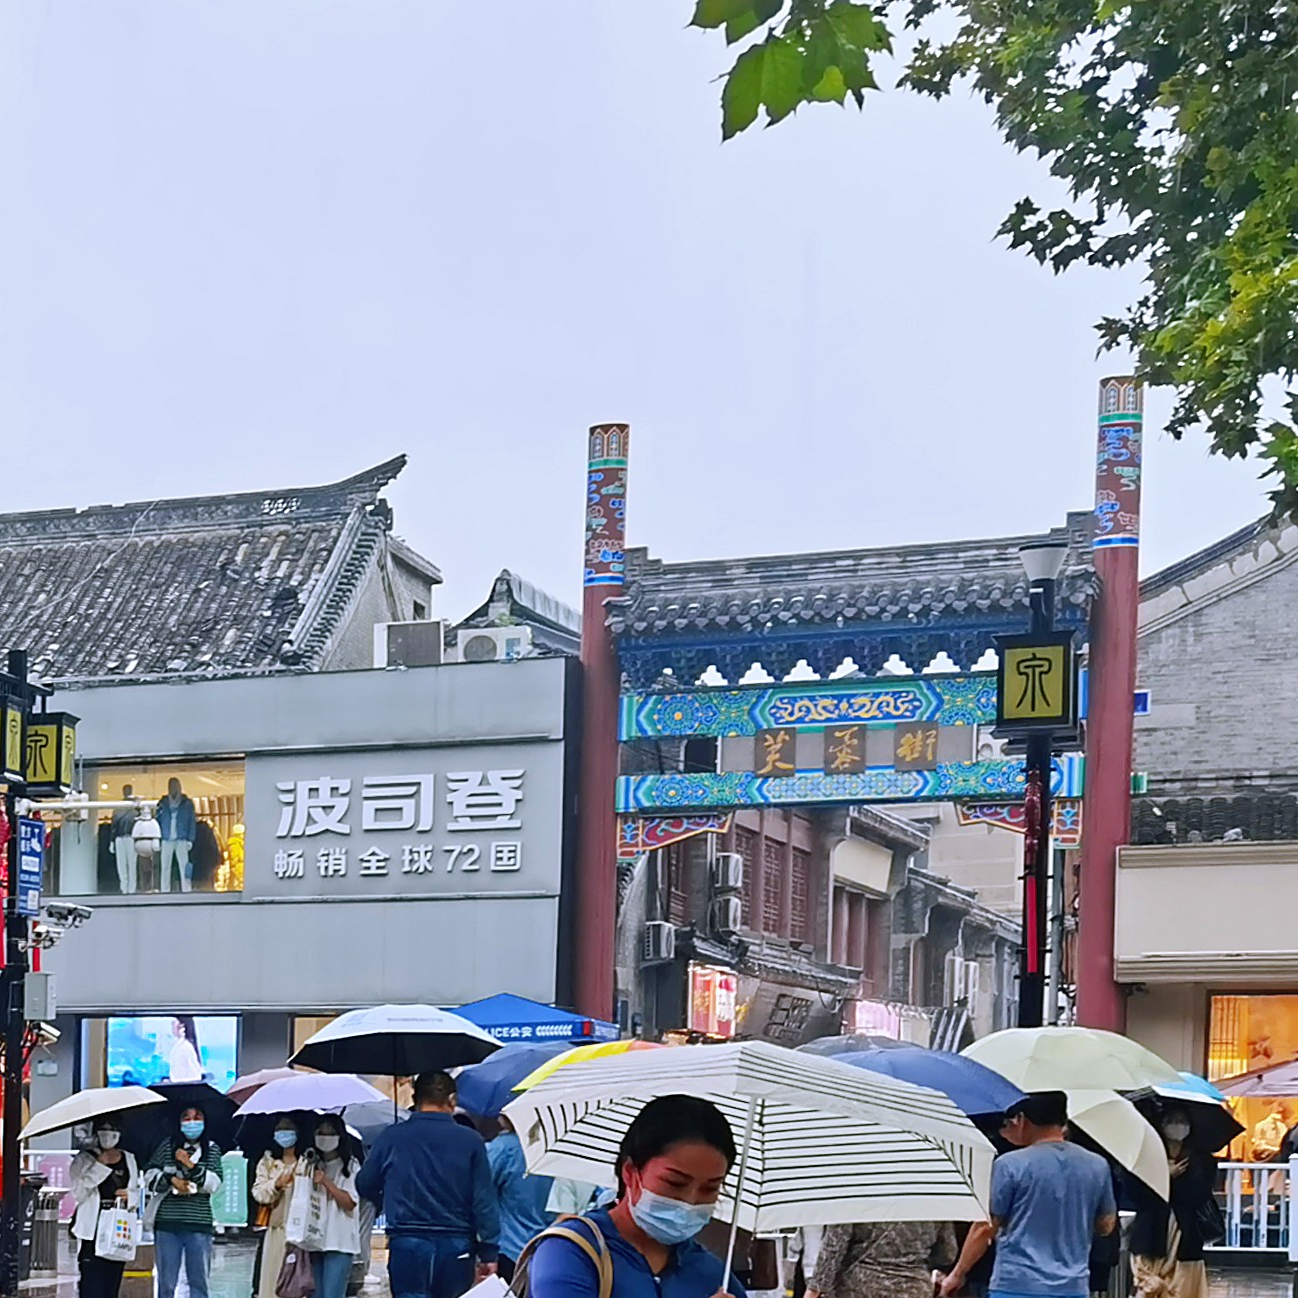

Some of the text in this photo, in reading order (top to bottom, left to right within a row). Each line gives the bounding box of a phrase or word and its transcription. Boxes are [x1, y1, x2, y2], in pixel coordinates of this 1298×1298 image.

[275, 768, 525, 838] 波司登
[274, 841, 522, 879] 畅销全球72国
